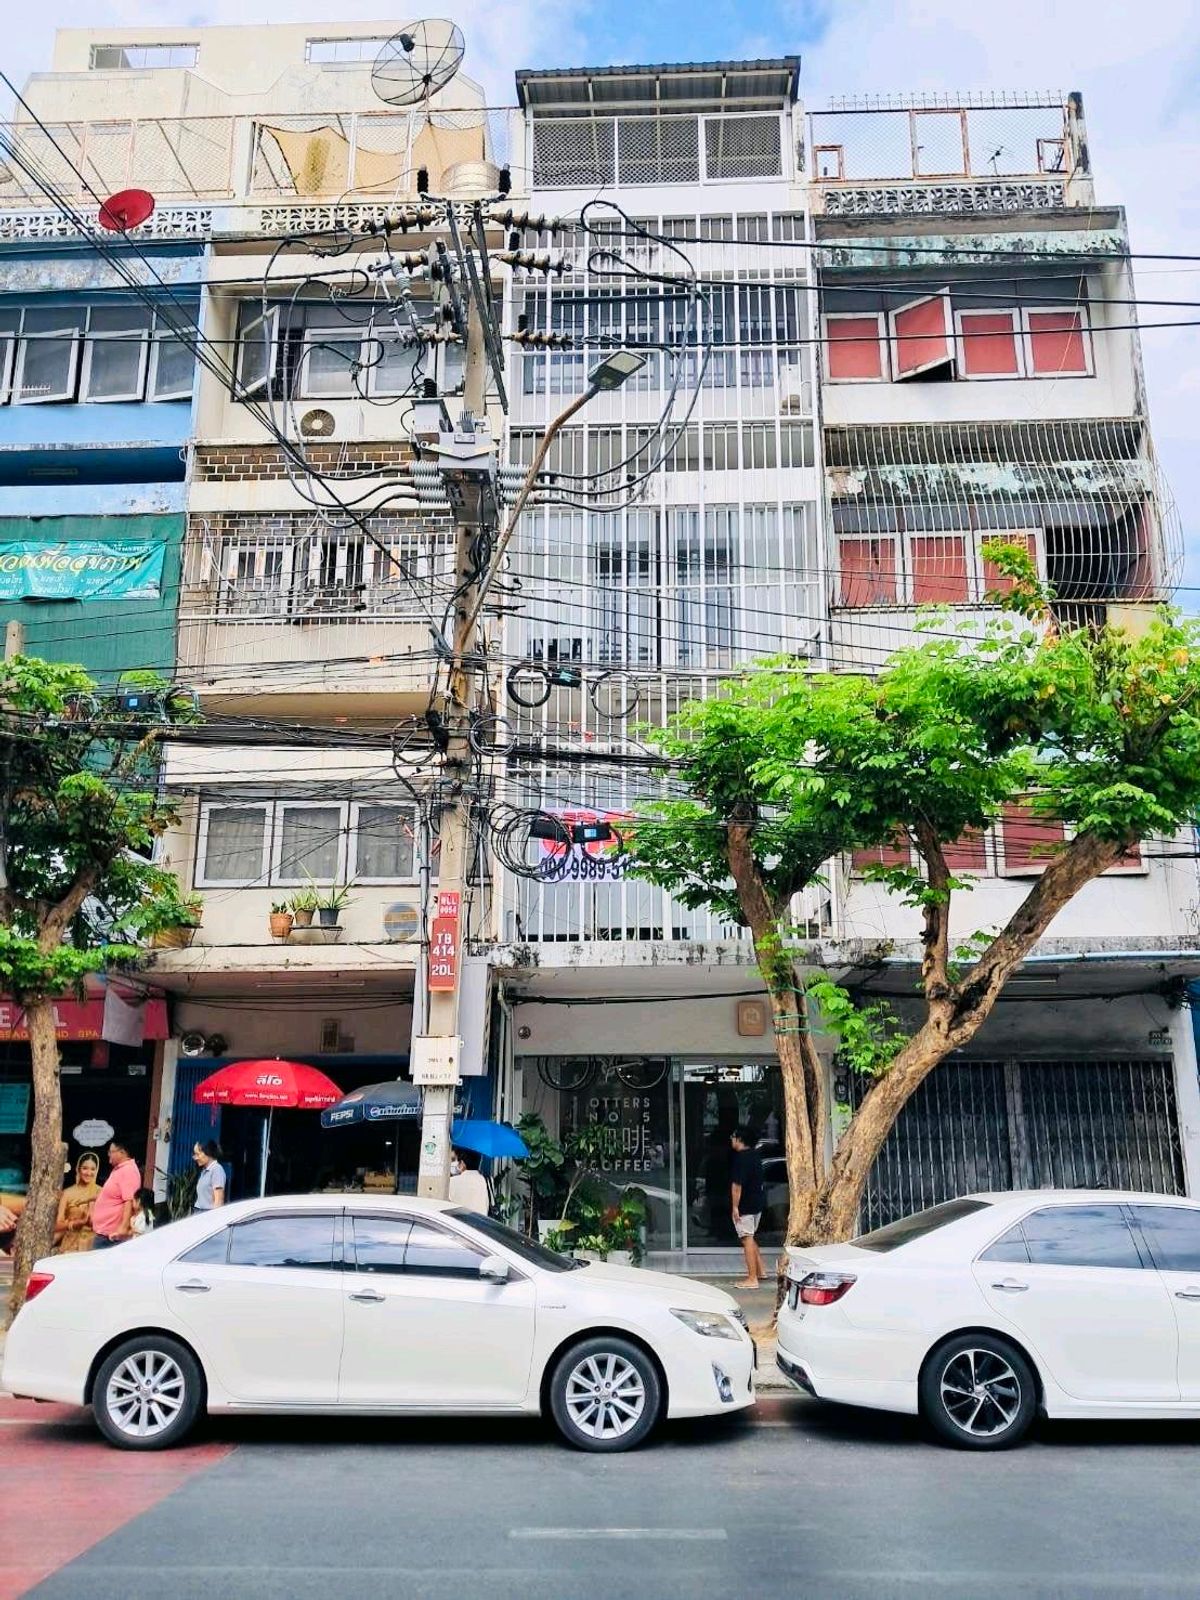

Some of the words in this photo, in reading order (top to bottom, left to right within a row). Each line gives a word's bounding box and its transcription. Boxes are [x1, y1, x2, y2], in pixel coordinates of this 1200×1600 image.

[0, 542, 145, 578] วดเพื่อสุขภาพ
[436, 933, 452, 945] TB
[432, 945, 455, 957] 414
[590, 1097, 651, 1109] OTTERS
[330, 1108, 355, 1121] PEPSI
